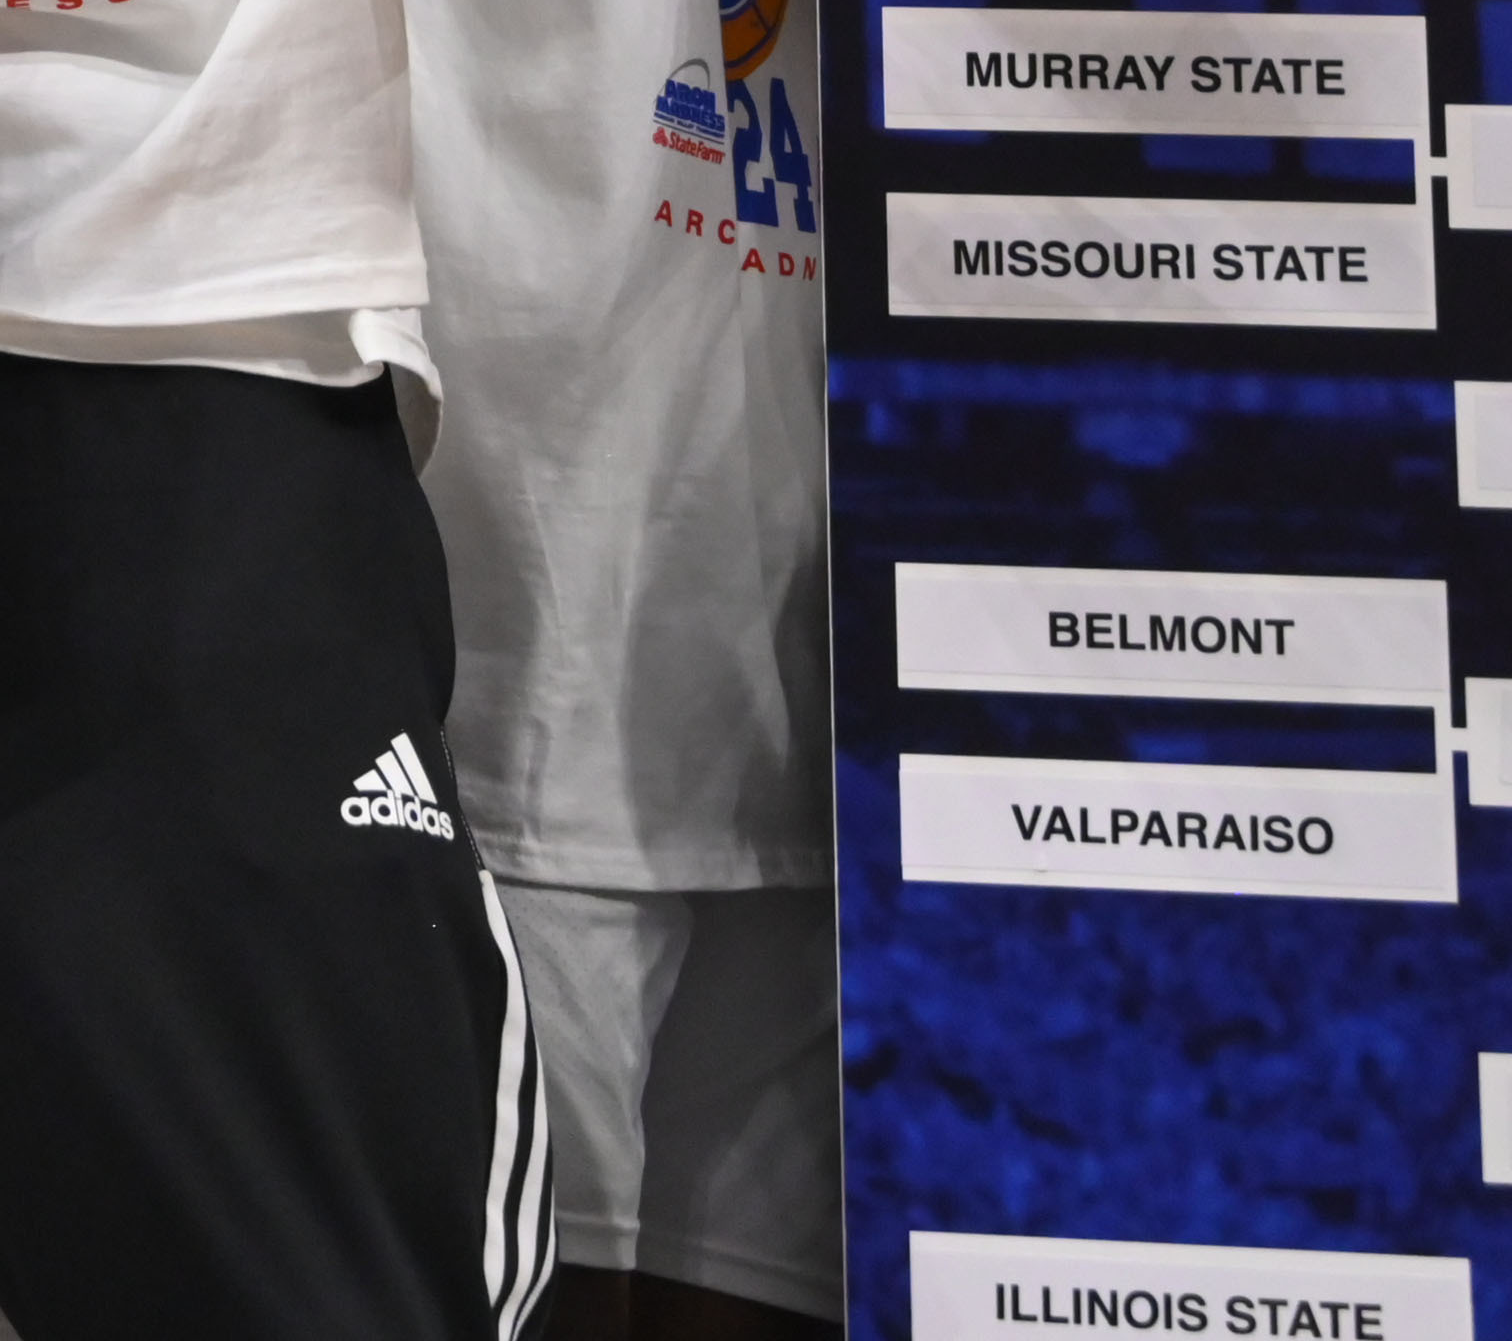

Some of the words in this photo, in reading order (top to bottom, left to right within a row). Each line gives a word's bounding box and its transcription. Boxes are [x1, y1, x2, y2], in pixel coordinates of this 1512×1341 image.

[965, 52, 1174, 92] MURRAY
[1191, 56, 1345, 96] STATE
[727, 77, 817, 234] 24
[654, 200, 736, 245] ARC
[952, 239, 1194, 280] MISSOURI
[1213, 243, 1368, 283] STATE
[1047, 610, 1295, 657] BELMONT
[340, 789, 454, 842] adidas
[1011, 803, 1334, 855] VALPARAISO
[995, 1282, 1207, 1332] ILLINOIS
[1226, 1294, 1384, 1341] STATE
